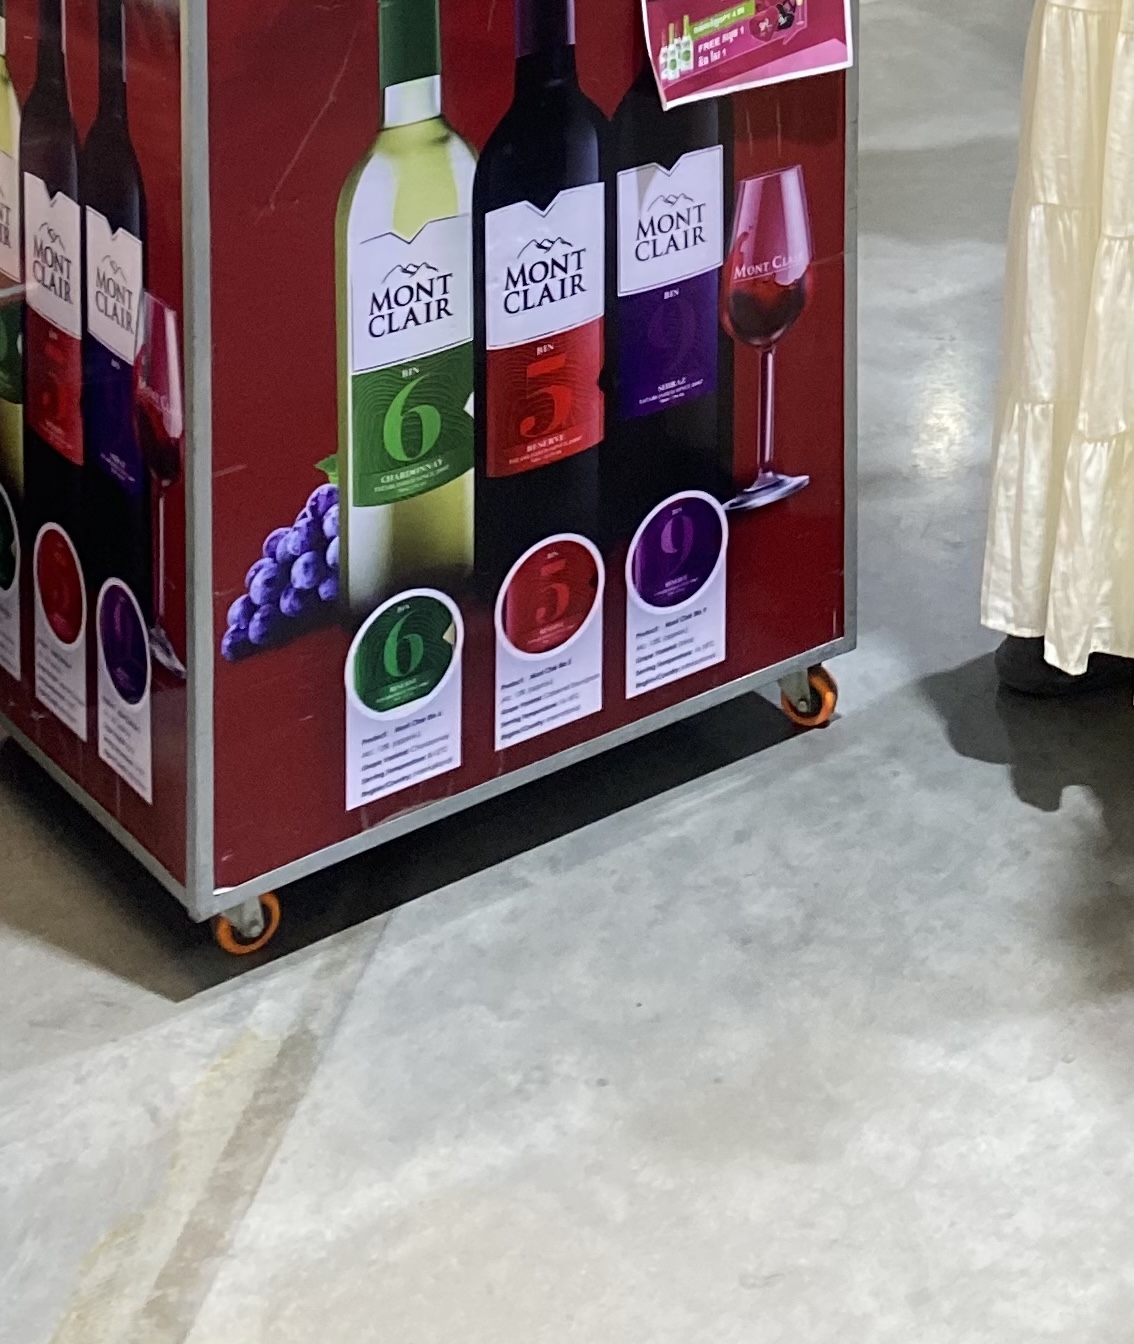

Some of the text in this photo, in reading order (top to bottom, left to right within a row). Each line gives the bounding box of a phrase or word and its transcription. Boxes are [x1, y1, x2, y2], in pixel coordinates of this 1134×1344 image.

[697, 37, 721, 54] FREE
[635, 202, 706, 241] MONT
[33, 234, 72, 280] MONT
[634, 226, 706, 262] CLAIR
[32, 259, 73, 305] CLAIR
[96, 266, 133, 310] MONT
[503, 248, 587, 291] MONT
[734, 260, 770, 280] MONT
[95, 290, 134, 334] CLAIR
[369, 273, 453, 316] MONT
[503, 272, 587, 314] CLAIR
[664, 288, 680, 300] BIN
[368, 297, 453, 338] CLAIR
[536, 343, 555, 355] BIN
[402, 366, 420, 378] BIN
[520, 352, 572, 438] 5
[384, 373, 441, 461] 6
[660, 514, 694, 574] 9
[536, 558, 571, 624] 5
[384, 611, 424, 678] 6
